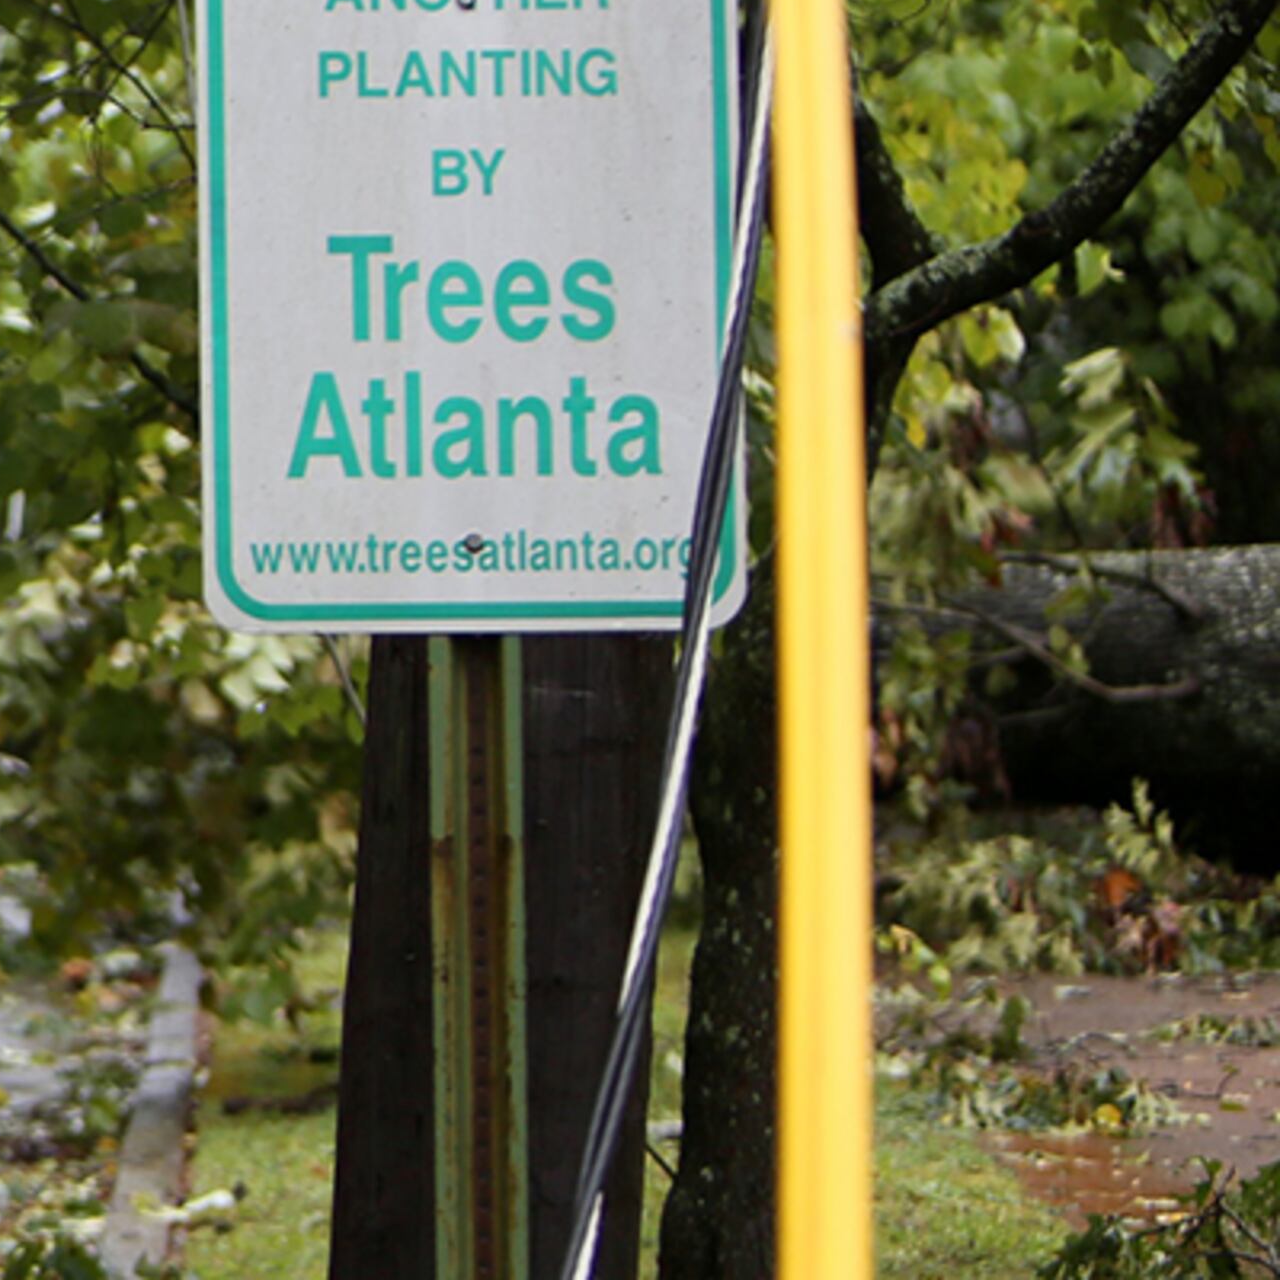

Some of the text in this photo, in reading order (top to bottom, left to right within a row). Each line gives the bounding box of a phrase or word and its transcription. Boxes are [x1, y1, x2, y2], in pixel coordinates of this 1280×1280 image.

[318, 48, 618, 98] PLANTING
[430, 149, 506, 197] BY
[326, 234, 616, 344] Trees
[286, 370, 662, 479] Atlanta
